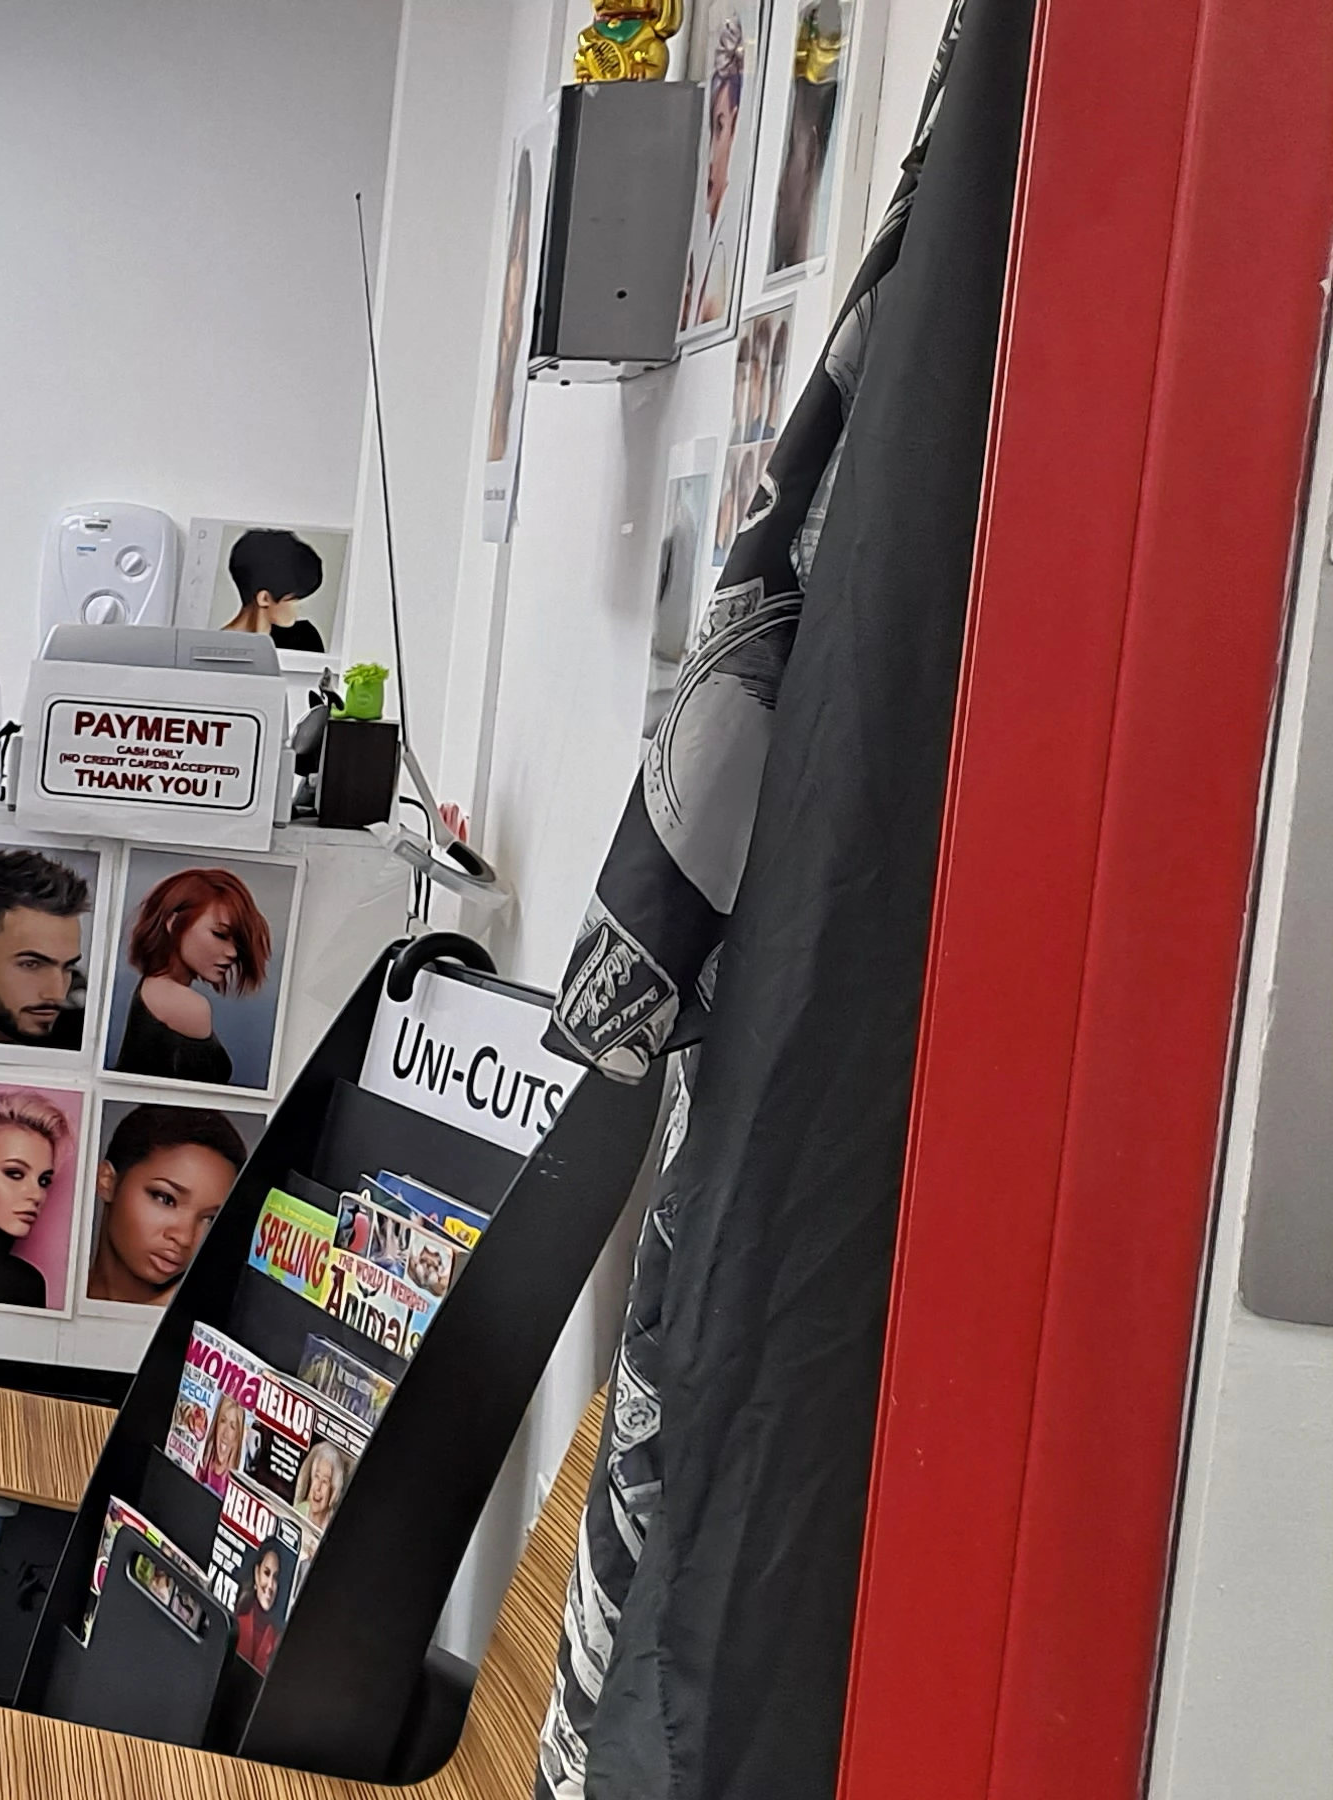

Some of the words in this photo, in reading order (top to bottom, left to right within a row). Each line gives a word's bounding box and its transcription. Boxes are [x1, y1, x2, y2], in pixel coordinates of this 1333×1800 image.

[74, 711, 231, 747] PAYMENT
[116, 745, 149, 757] CASH
[152, 748, 185, 759] ONLY
[59, 752, 81, 764] (NO
[83, 755, 126, 767] CREDIT
[128, 758, 169, 770] CARDS
[171, 762, 240, 778] ACCEPTED)
[75, 768, 153, 792] THANK
[158, 774, 208, 797] YOU
[214, 780, 222, 798] !
[255, 1212, 330, 1289] SPELLING
[184, 1334, 262, 1409] woma
[257, 1378, 314, 1440] HELLO!
[222, 1480, 277, 1542] HELLO!
